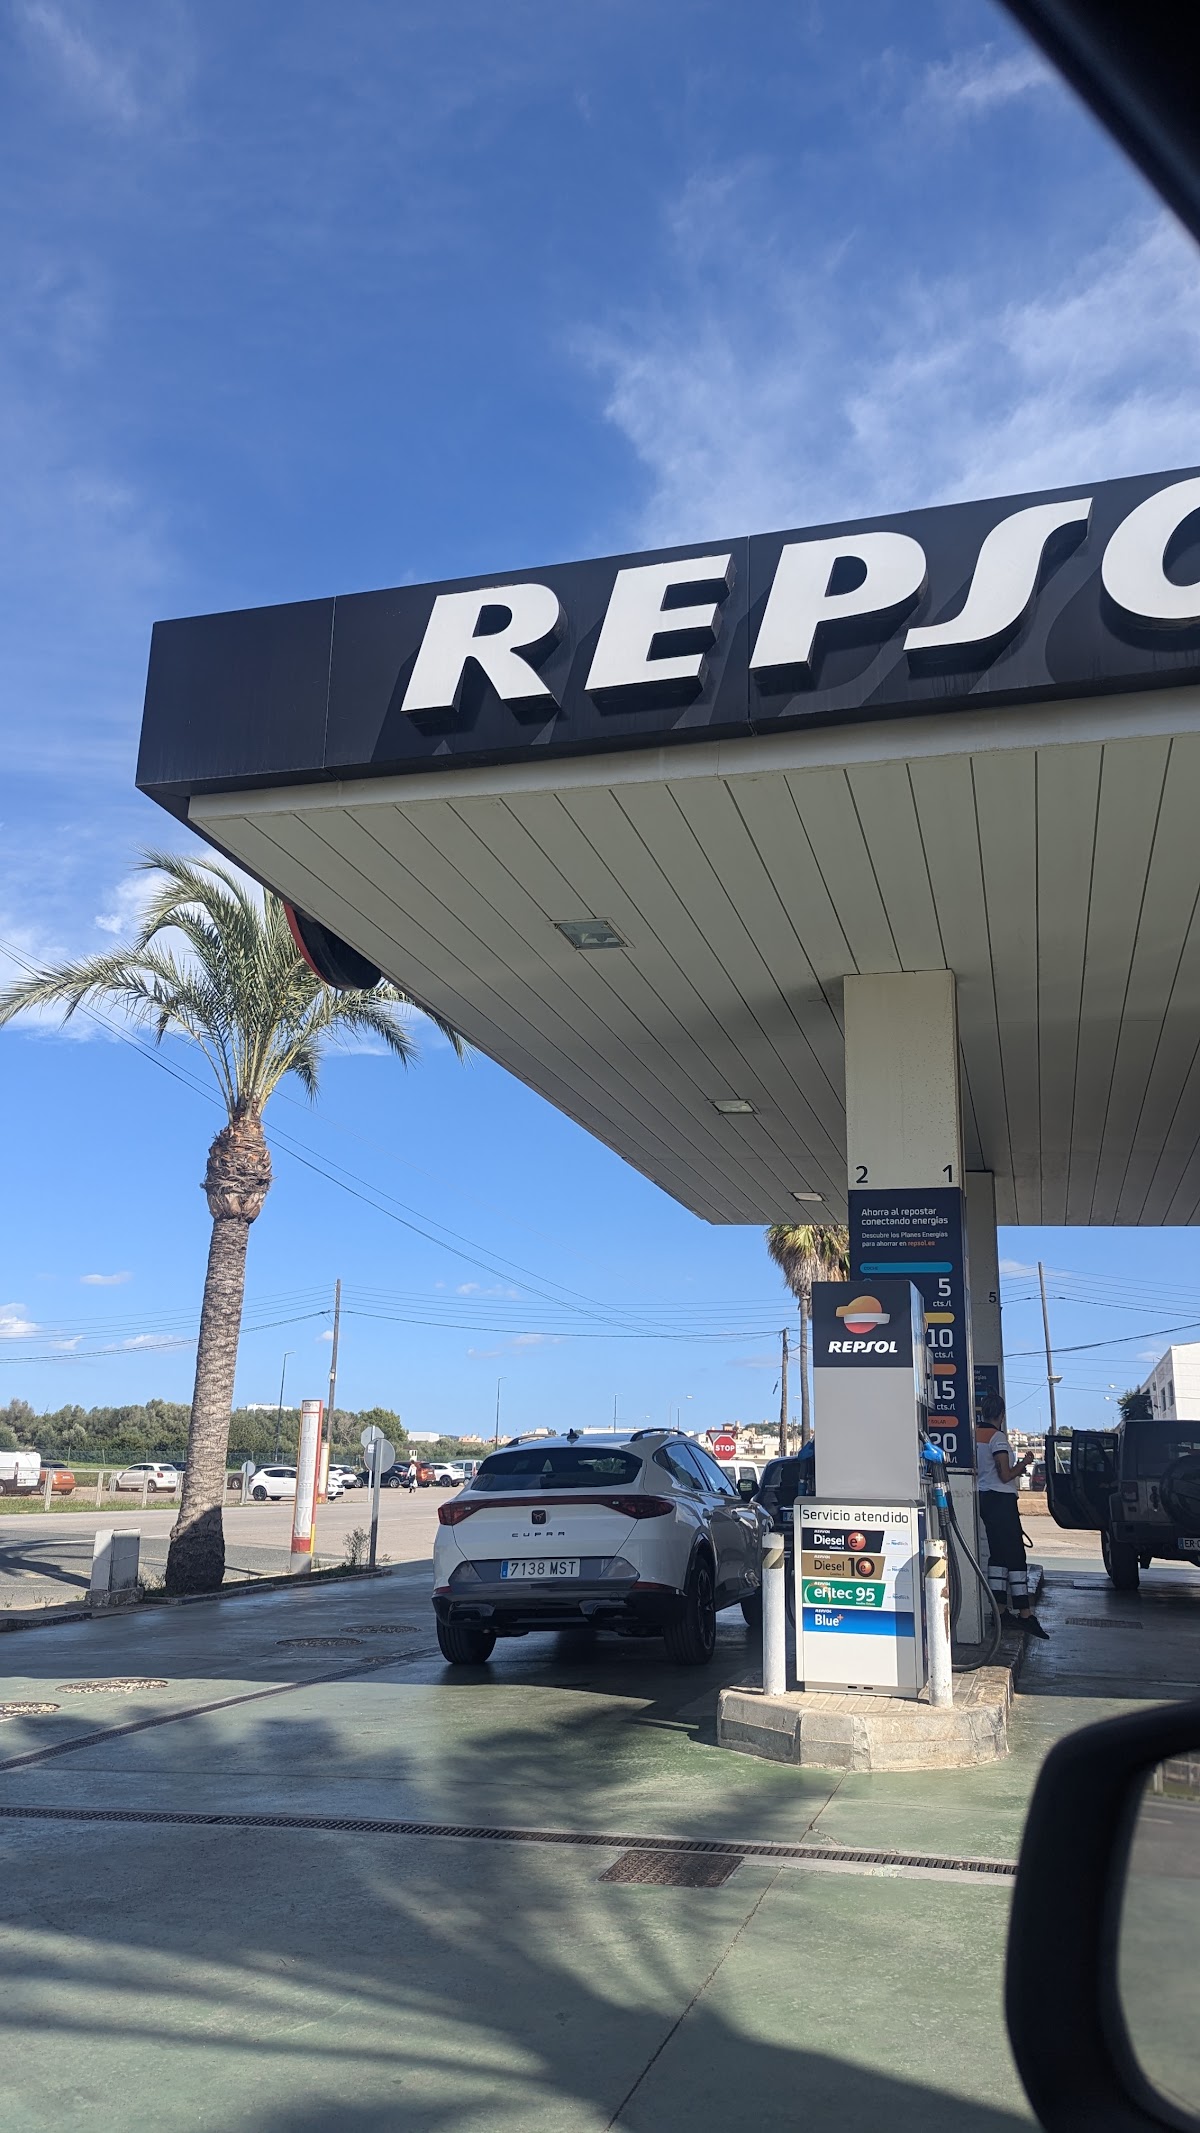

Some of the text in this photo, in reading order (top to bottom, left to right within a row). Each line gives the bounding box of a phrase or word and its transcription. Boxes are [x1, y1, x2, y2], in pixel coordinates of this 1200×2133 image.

[855, 1165, 868, 1184] 2
[942, 1164, 953, 1183] 1
[861, 1207, 937, 1217] Ahorra al repostar
[861, 1216, 949, 1226] conectando energías
[922, 1231, 949, 1240] Energías
[938, 1278, 951, 1297] 5
[988, 1291, 997, 1303] 5
[928, 1328, 953, 1348] 10
[828, 1340, 898, 1354] REPSOL
[933, 1380, 956, 1400] 15
[715, 1444, 735, 1452] STOP
[802, 1509, 851, 1521] Servicio
[854, 1511, 909, 1524] atendido
[814, 1534, 845, 1546] Diesel
[510, 1562, 545, 1576] 7138
[550, 1561, 576, 1575] MST
[814, 1560, 845, 1571] Diesel
[814, 1587, 853, 1600] efitec
[855, 1587, 876, 1602] 95
